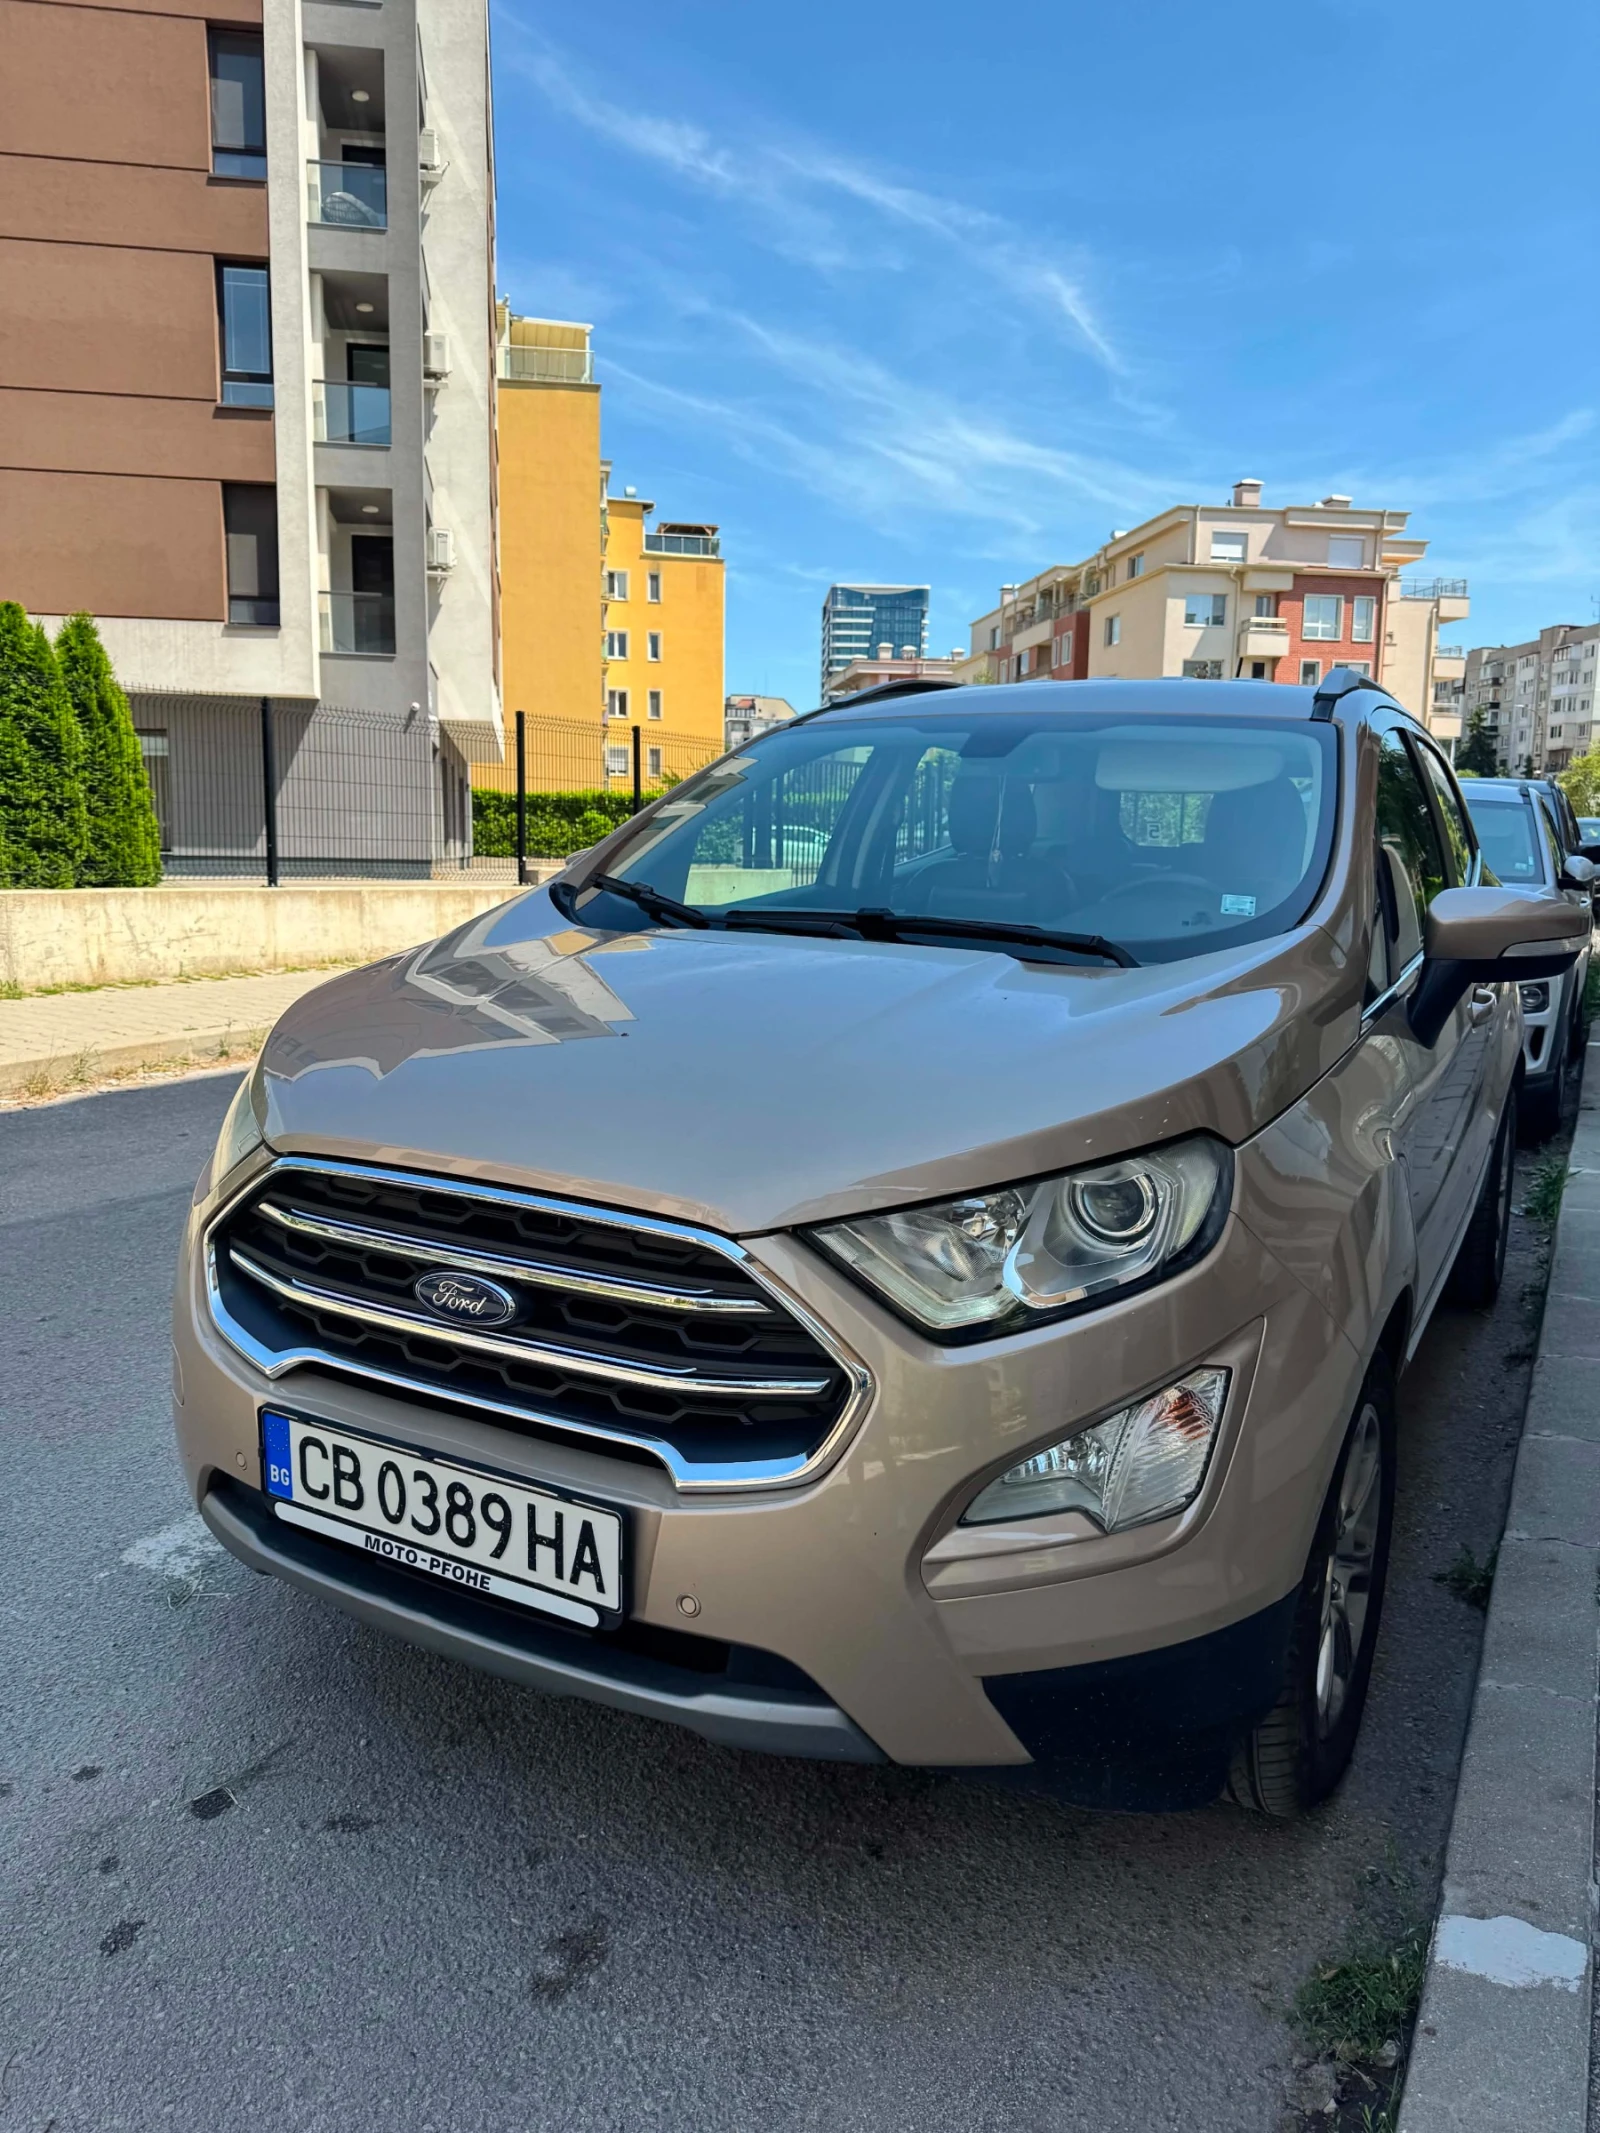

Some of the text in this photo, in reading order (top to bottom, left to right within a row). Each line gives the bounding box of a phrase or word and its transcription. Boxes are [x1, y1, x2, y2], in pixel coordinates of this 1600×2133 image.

[432, 1280, 488, 1315] Ford
[270, 1463, 290, 1487] BG
[364, 1533, 492, 1591] MOTO-PFOHE
